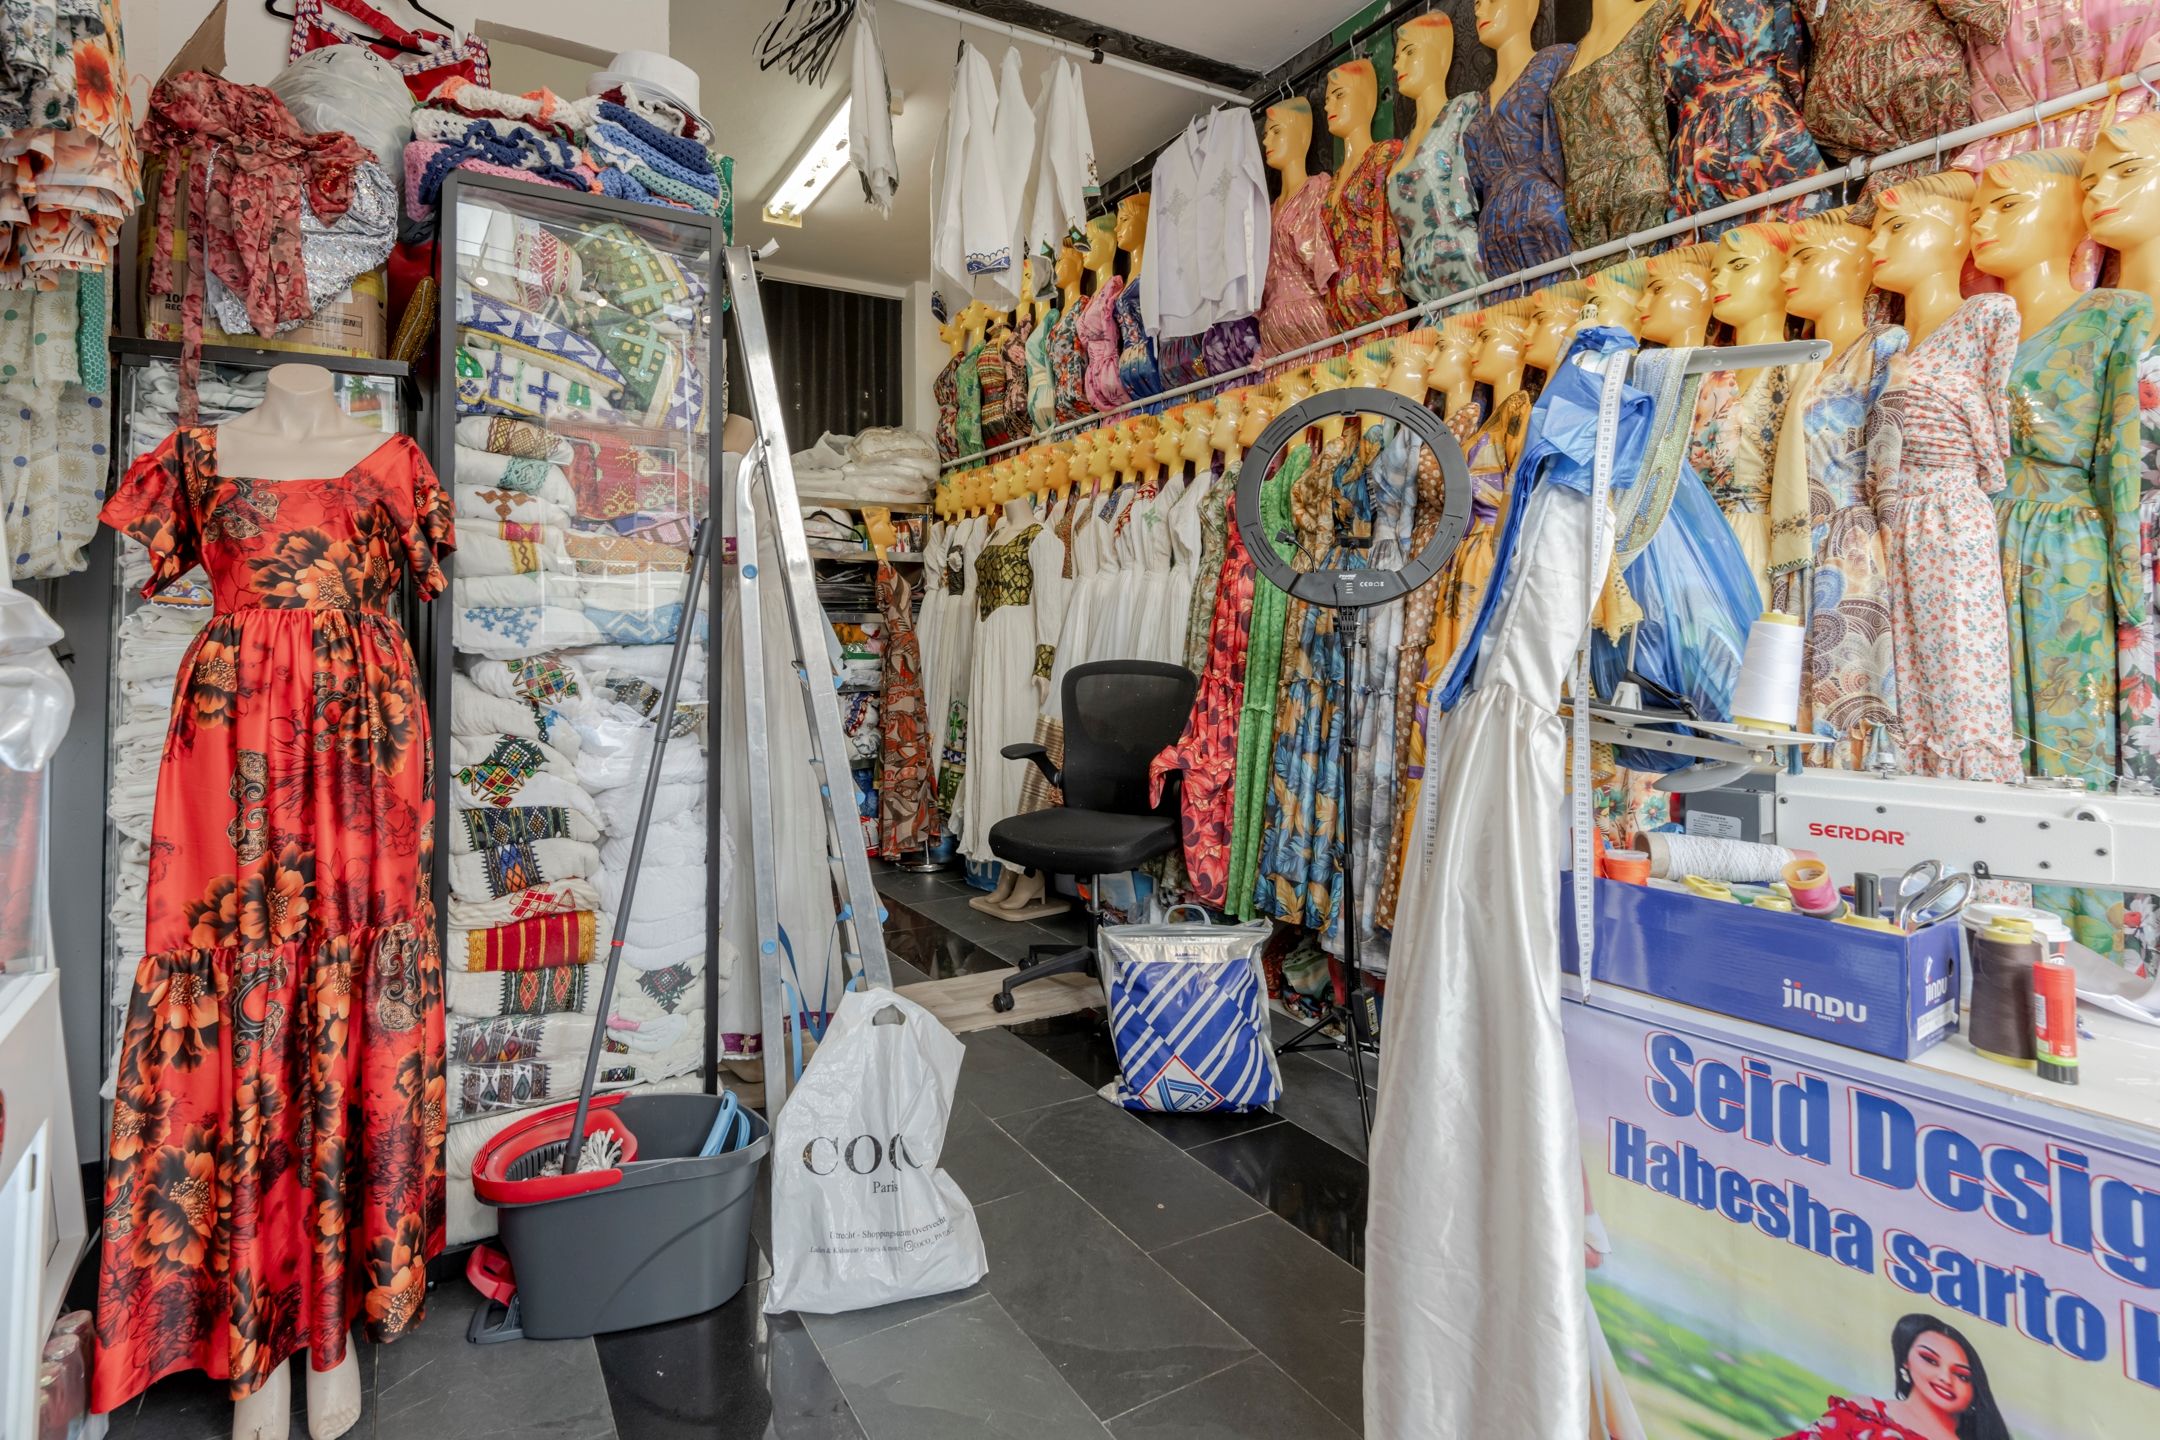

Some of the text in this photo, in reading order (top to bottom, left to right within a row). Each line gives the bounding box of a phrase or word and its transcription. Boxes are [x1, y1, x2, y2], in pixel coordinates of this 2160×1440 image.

[165, 294, 183, 302] 10
[1808, 822, 1905, 846] SERDAR
[1645, 1030, 2160, 1289] Seid Desig
[873, 1180, 898, 1194] Paris
[1608, 1117, 1875, 1275] Habesha
[1884, 1229, 2107, 1363] sarto
